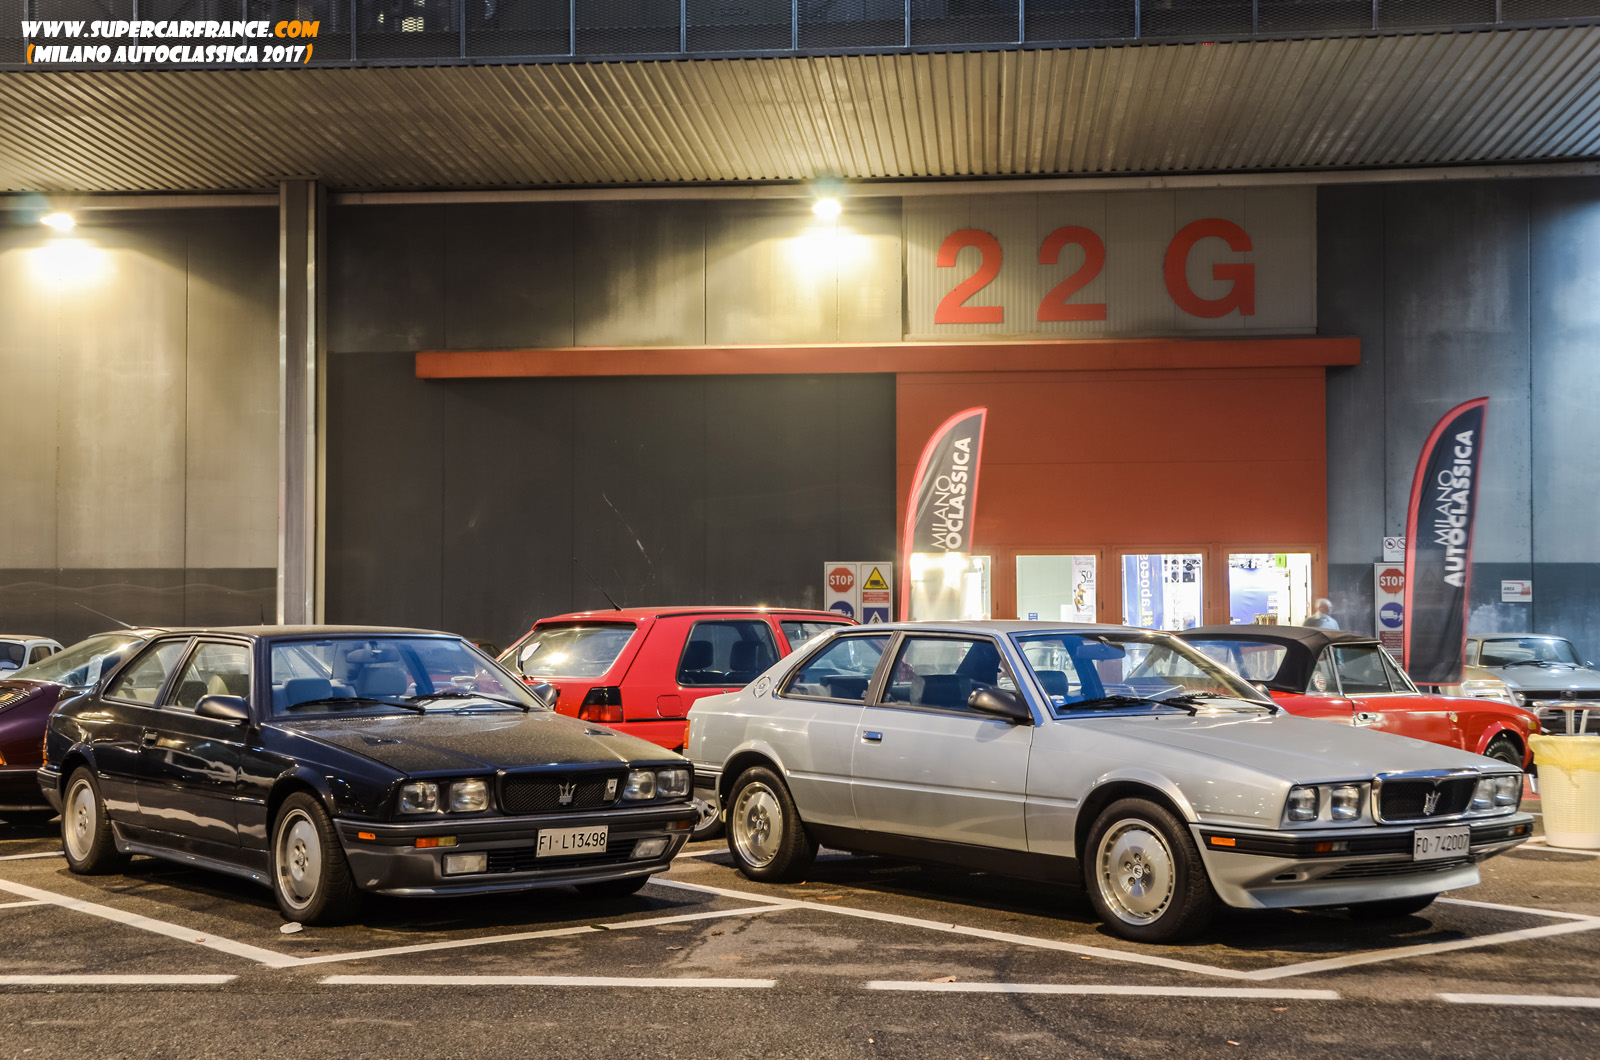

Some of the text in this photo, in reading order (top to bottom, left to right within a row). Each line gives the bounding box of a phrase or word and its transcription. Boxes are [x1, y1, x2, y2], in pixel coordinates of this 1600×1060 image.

[1163, 218, 1255, 319] G
[931, 475, 951, 549] MILANO
[945, 437, 972, 552] OCLASSICA
[1433, 470, 1453, 547] MILANO
[1444, 430, 1474, 588] AUTOCLASSICA
[829, 575, 854, 586] STOP
[1080, 570, 1092, 584] 50
[1380, 576, 1405, 587] STOP
